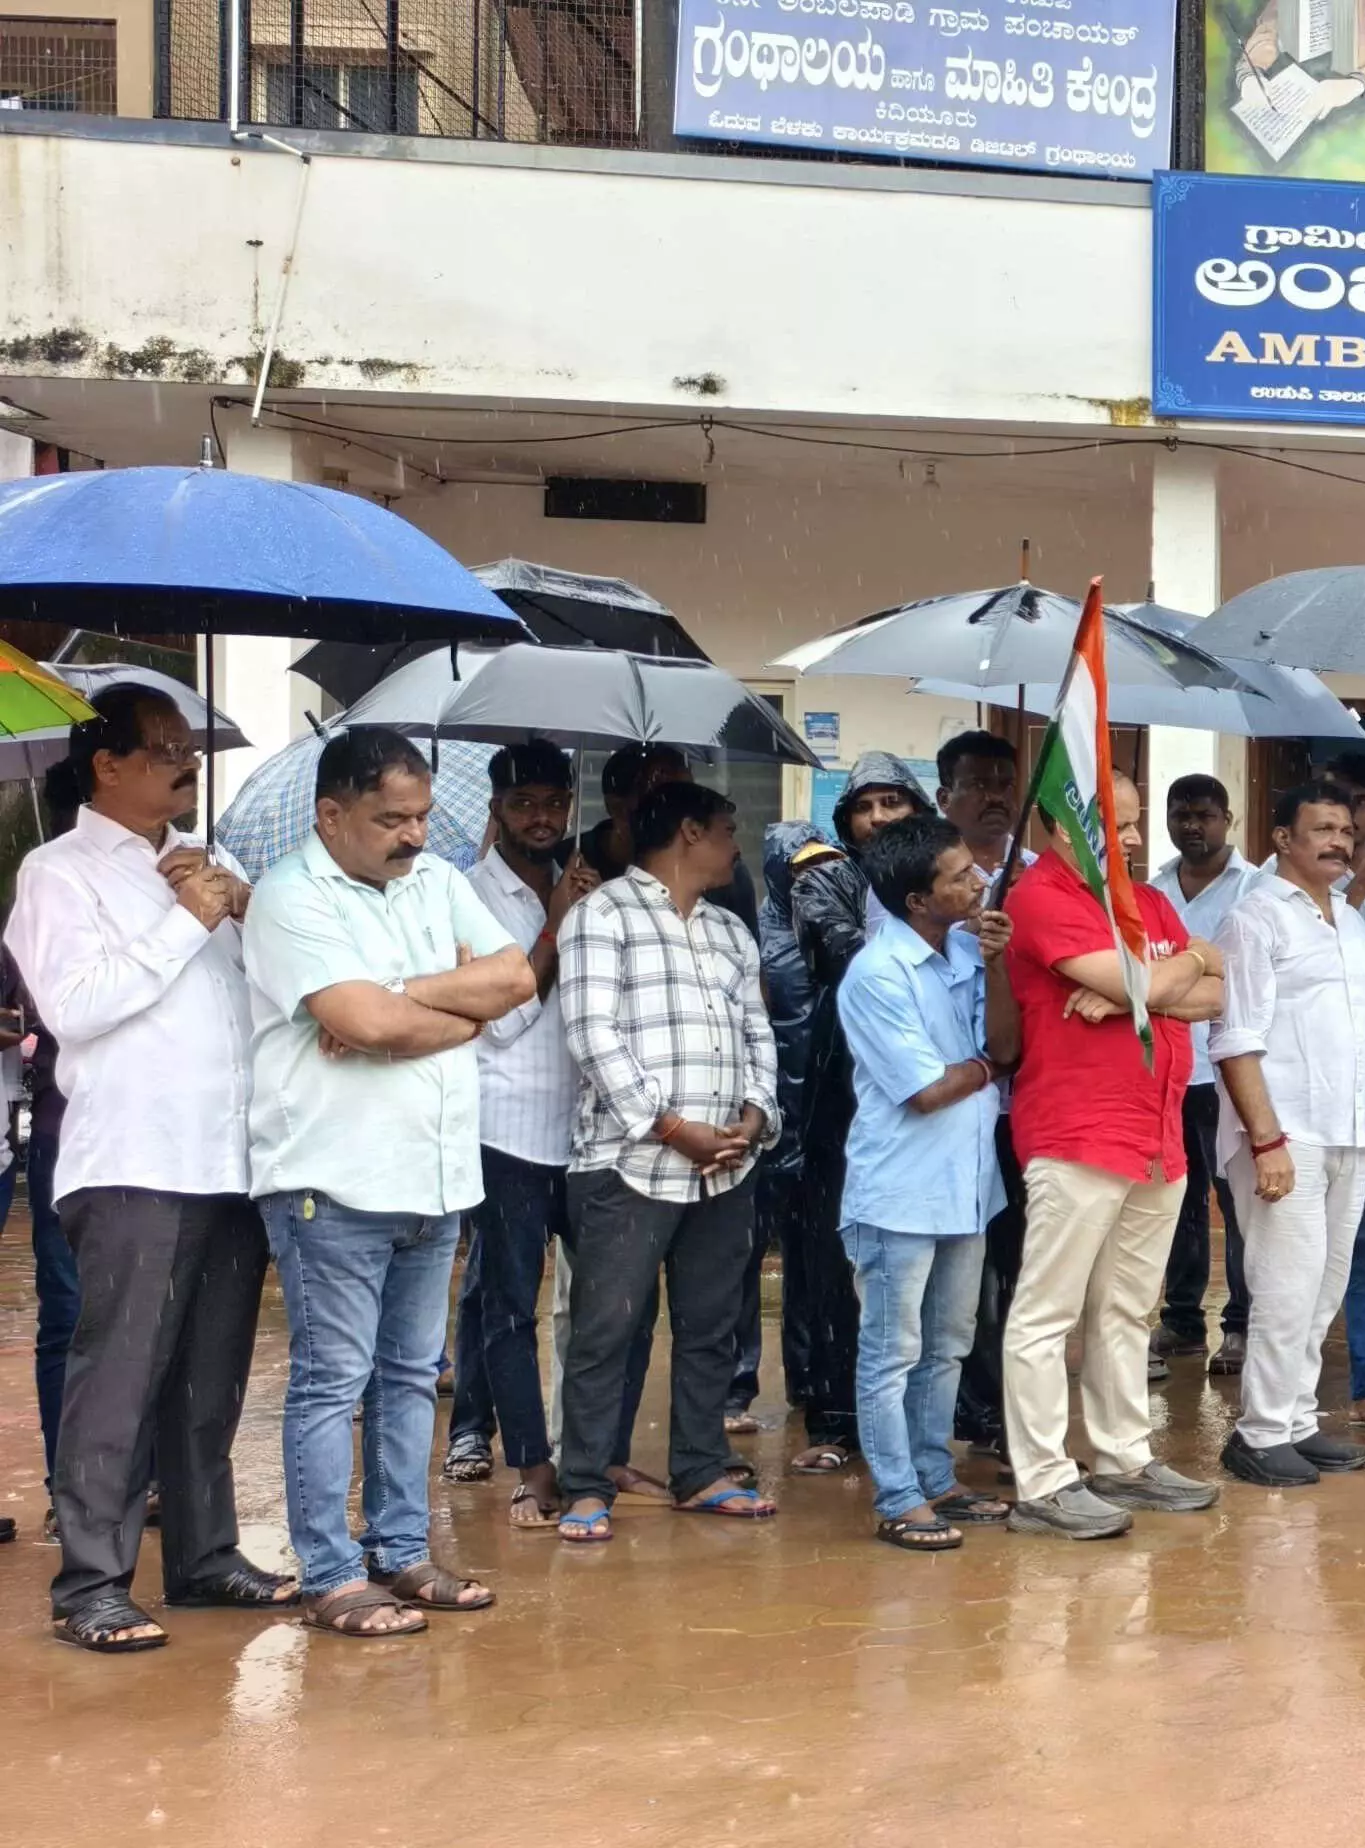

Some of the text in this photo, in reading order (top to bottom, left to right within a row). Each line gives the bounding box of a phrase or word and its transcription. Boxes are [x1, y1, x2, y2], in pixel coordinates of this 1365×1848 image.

[929, 7, 990, 37] ಗ್ರಾಮ
[1004, 13, 1139, 46] ಪಂಚಾಯತ್
[693, 10, 1158, 138] ಗ್ರಂಥಾಲಯ ಹಾಗೂ ಮಾಹಿತಿ ಕೇಂದ್ರ
[875, 100, 977, 128] ಕಿದಿಯೂರು
[1045, 144, 1136, 169] ಗ್ರಂಥಾಲಯ
[1250, 384, 1314, 401] ಉಡುಪಿ
